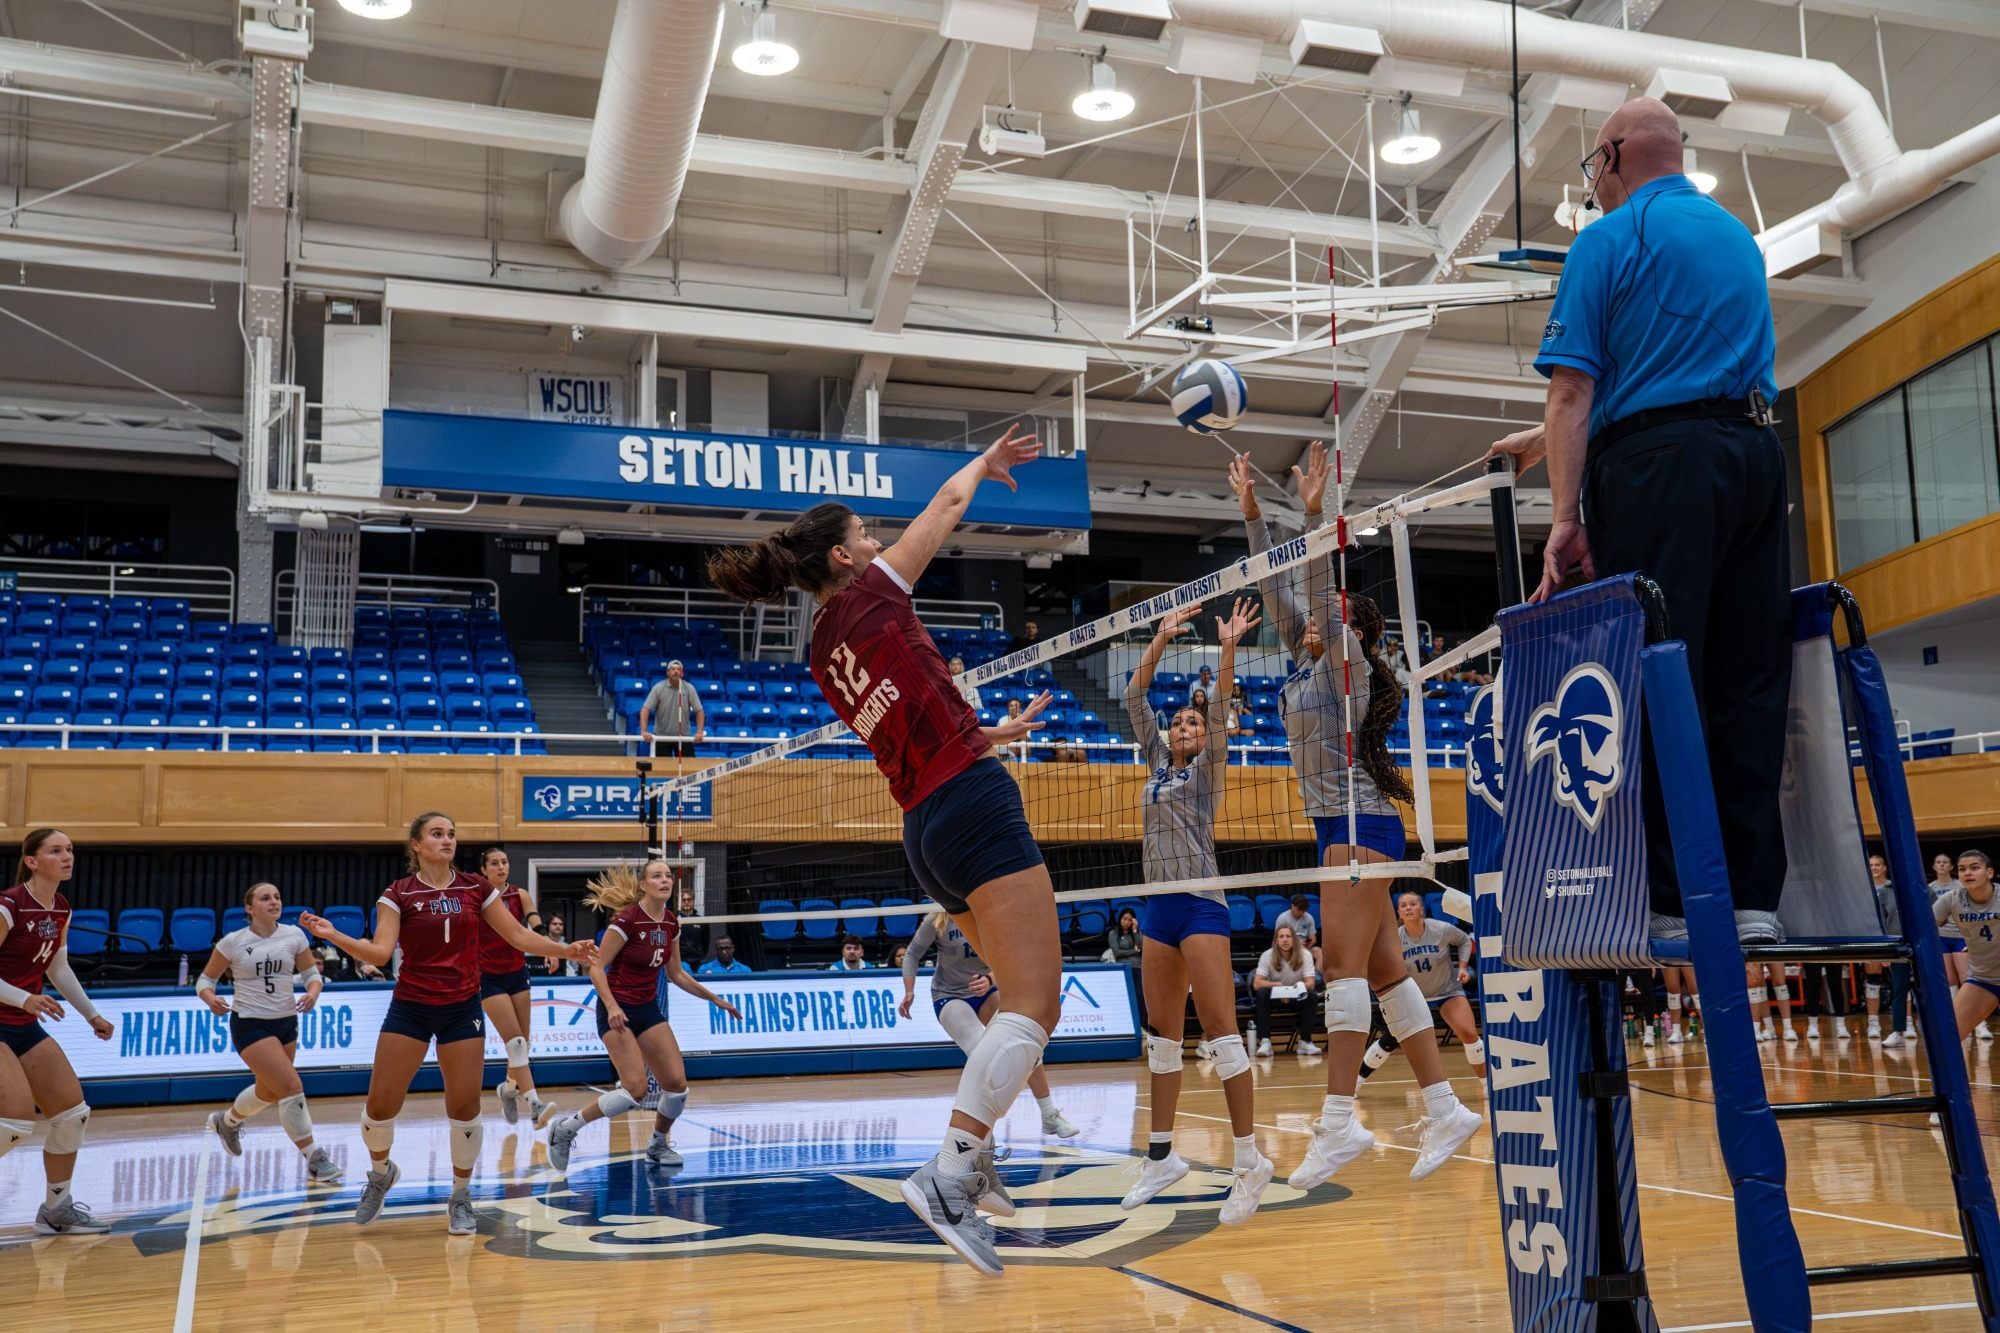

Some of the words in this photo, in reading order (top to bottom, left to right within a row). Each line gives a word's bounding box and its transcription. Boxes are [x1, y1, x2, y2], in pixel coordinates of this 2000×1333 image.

[539, 377, 606, 414] WSOU
[563, 414, 613, 426] SPORTS
[618, 435, 763, 490] SETON
[775, 445, 893, 499] HALL
[1267, 536, 1307, 570] PIRATES
[475, 597, 487, 609] 15
[1129, 600, 1152, 624] SETON
[1153, 592, 1173, 614] HALL
[1174, 571, 1222, 607] UNIVERSITY
[983, 619, 994, 630] 14
[1069, 622, 1096, 647] PIRATES
[977, 666, 993, 681] SETON
[992, 658, 1008, 676] HALL
[1007, 644, 1040, 670] UNIVERSITY
[827, 641, 871, 707] 12
[852, 678, 900, 741] KNIGHTS
[566, 804, 702, 812] ATHLECS
[1558, 865, 1613, 880] SETONHALLVBALL
[1557, 884, 1595, 897] SHUVOLLEY
[429, 898, 462, 915] FDU
[1958, 912, 2000, 922] PIRATE
[444, 917, 450, 944] 1
[650, 930, 668, 946] FDU
[1979, 924, 1993, 942] 4
[33, 940, 54, 963] 14
[648, 948, 665, 968] 15
[1402, 944, 1439, 960] PIRATES
[256, 959, 282, 976] FDU
[1414, 957, 1432, 973] 14
[264, 976, 275, 994] 5
[709, 989, 897, 1035] MHAINSPIRE.ORG
[120, 1004, 353, 1057] MHAINS.ORG
[546, 1045, 569, 1053] AND
